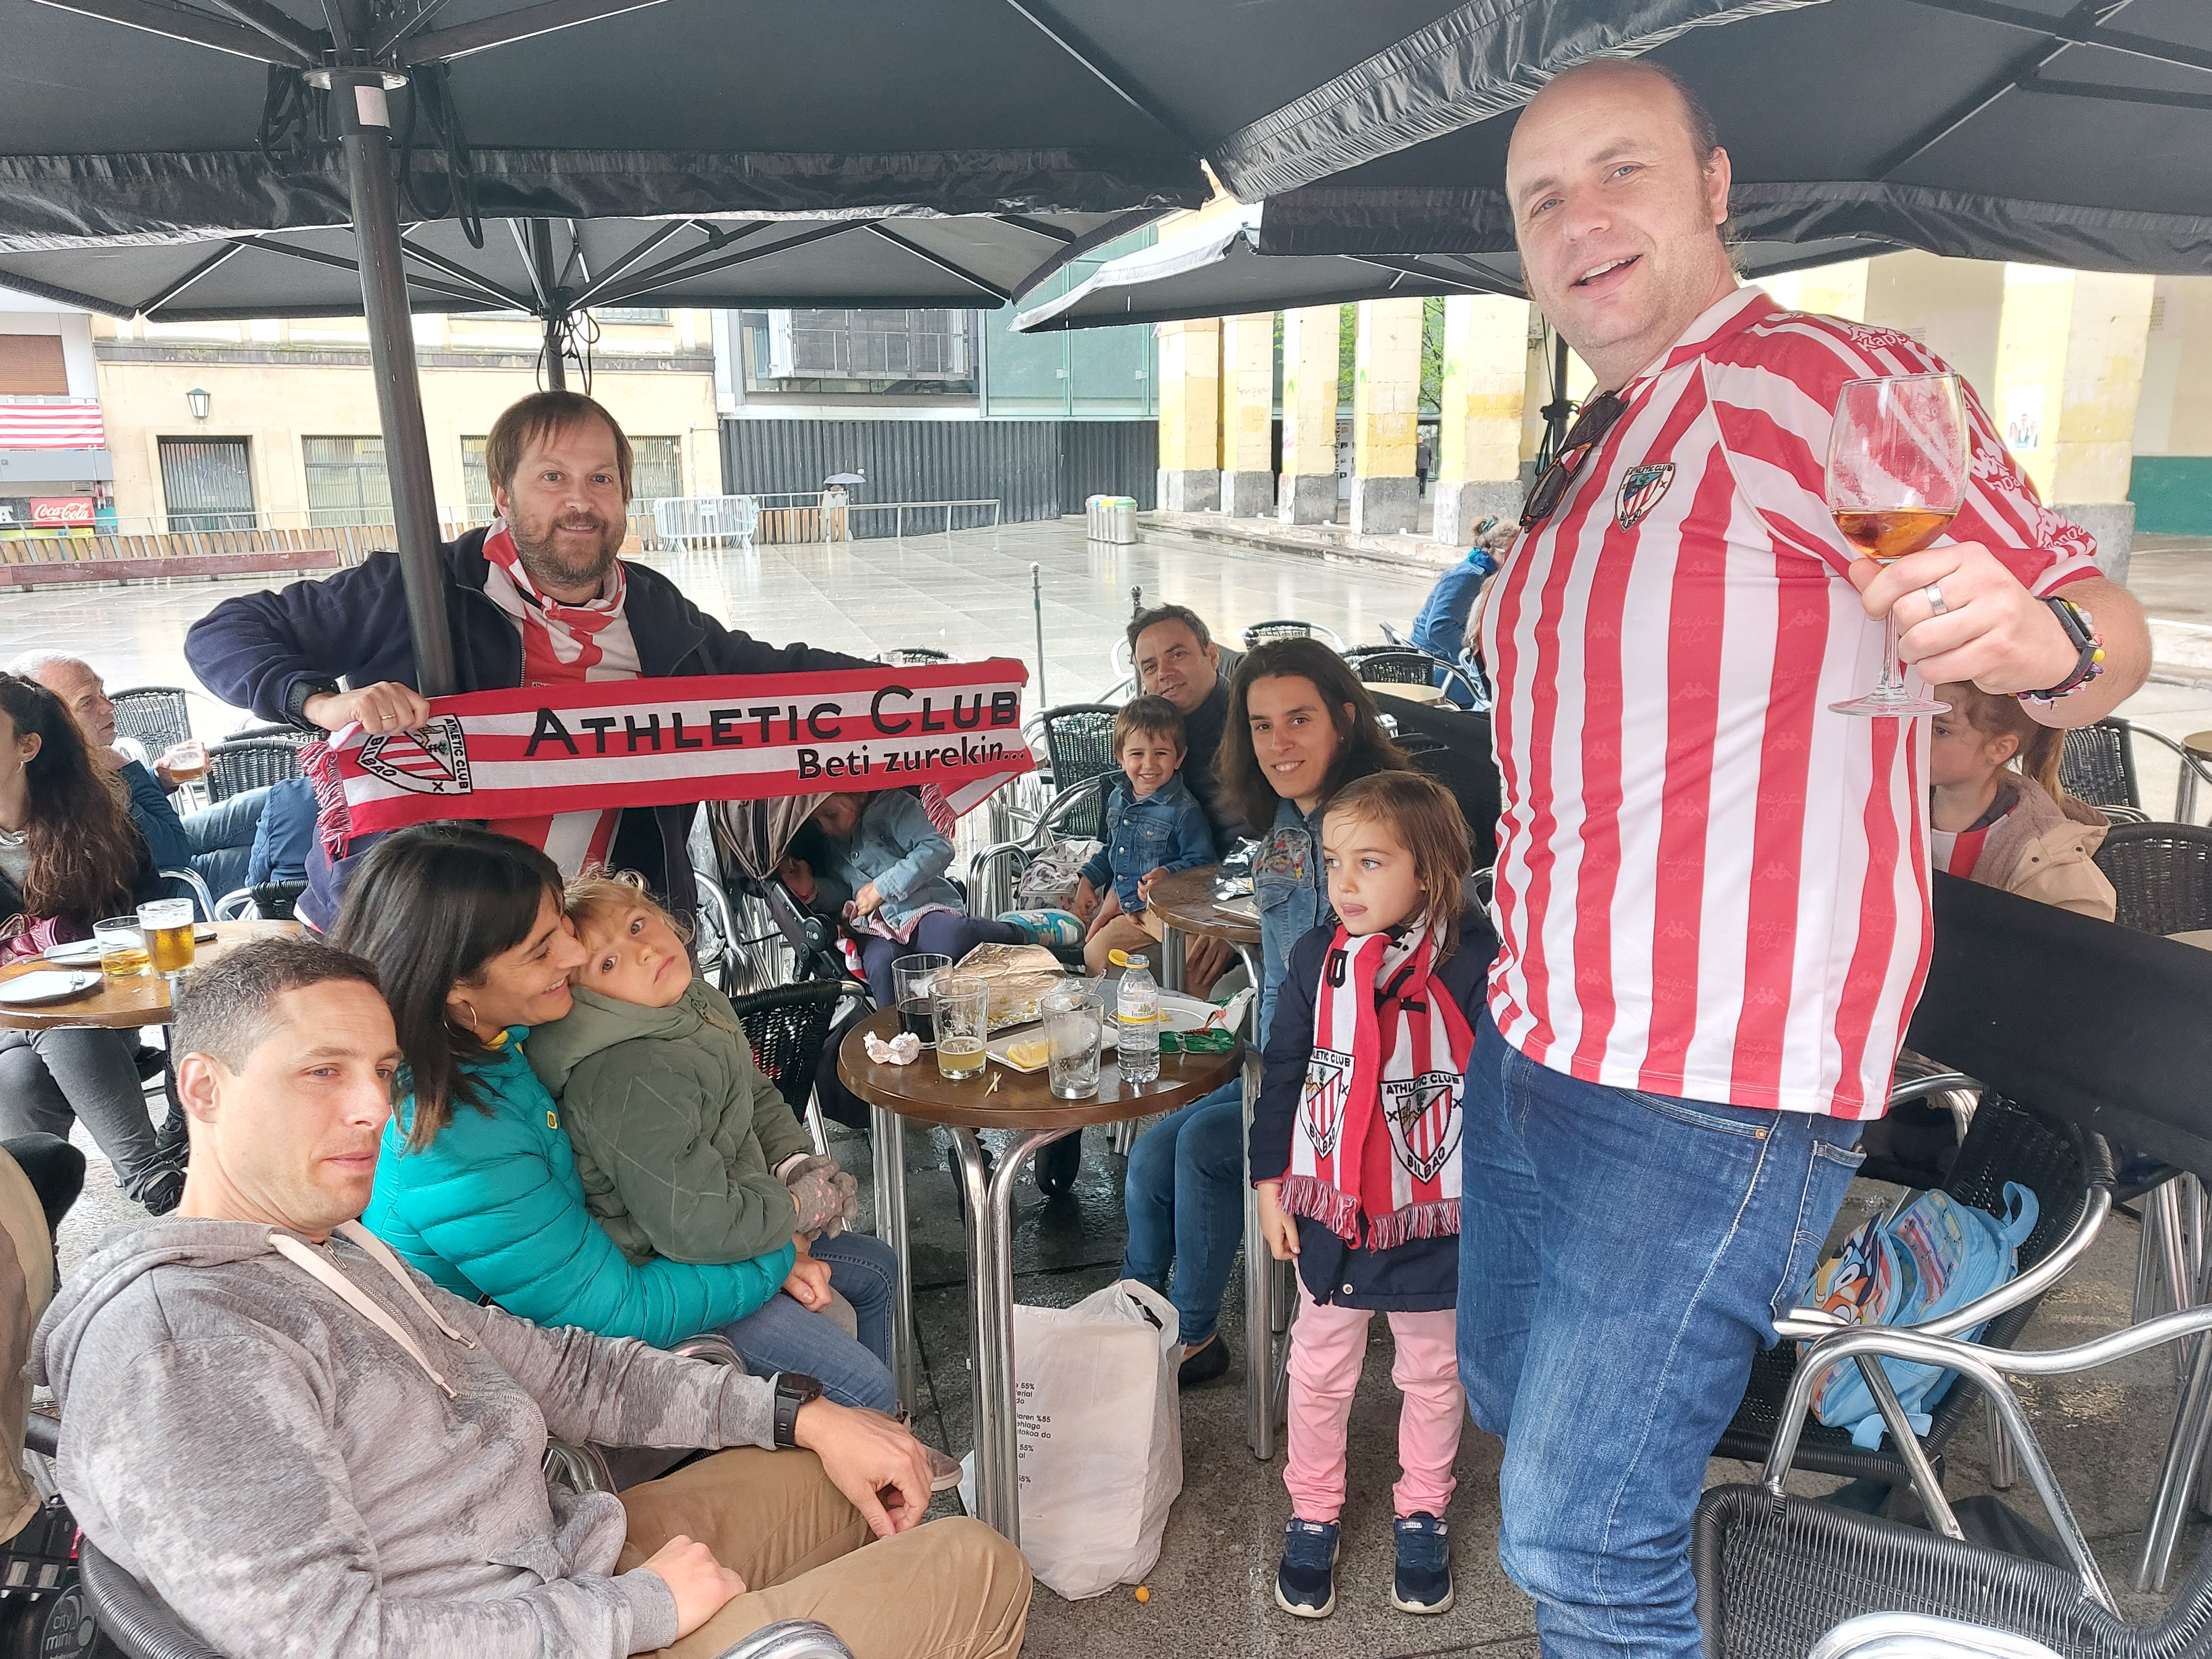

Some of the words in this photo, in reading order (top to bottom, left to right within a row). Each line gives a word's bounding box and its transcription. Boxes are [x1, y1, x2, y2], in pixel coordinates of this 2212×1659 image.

[34, 502, 91, 521] Coca-Cola
[1620, 509, 1641, 528] BILBAO
[524, 702, 842, 756] ATHLETIC
[871, 685, 1018, 734] CLUB
[361, 735, 397, 777] BILBAO
[444, 719, 464, 757] ATHLETIC
[455, 760, 469, 790] CLUB
[797, 744, 870, 779] Beti
[883, 735, 1025, 773] zurekin...
[1331, 1055, 1350, 1067] CLUB
[1386, 1076, 1427, 1095] ATHLTIC
[1430, 1074, 1460, 1084] CLUB
[1309, 1122, 1336, 1154] BILBAO
[1407, 1146, 1446, 1180] BILBAO
[1020, 1382, 1035, 1390] 55%
[1036, 1415, 1051, 1423] %55
[1017, 1428, 1039, 1437] takoa
[1019, 1444, 1034, 1452] 55%
